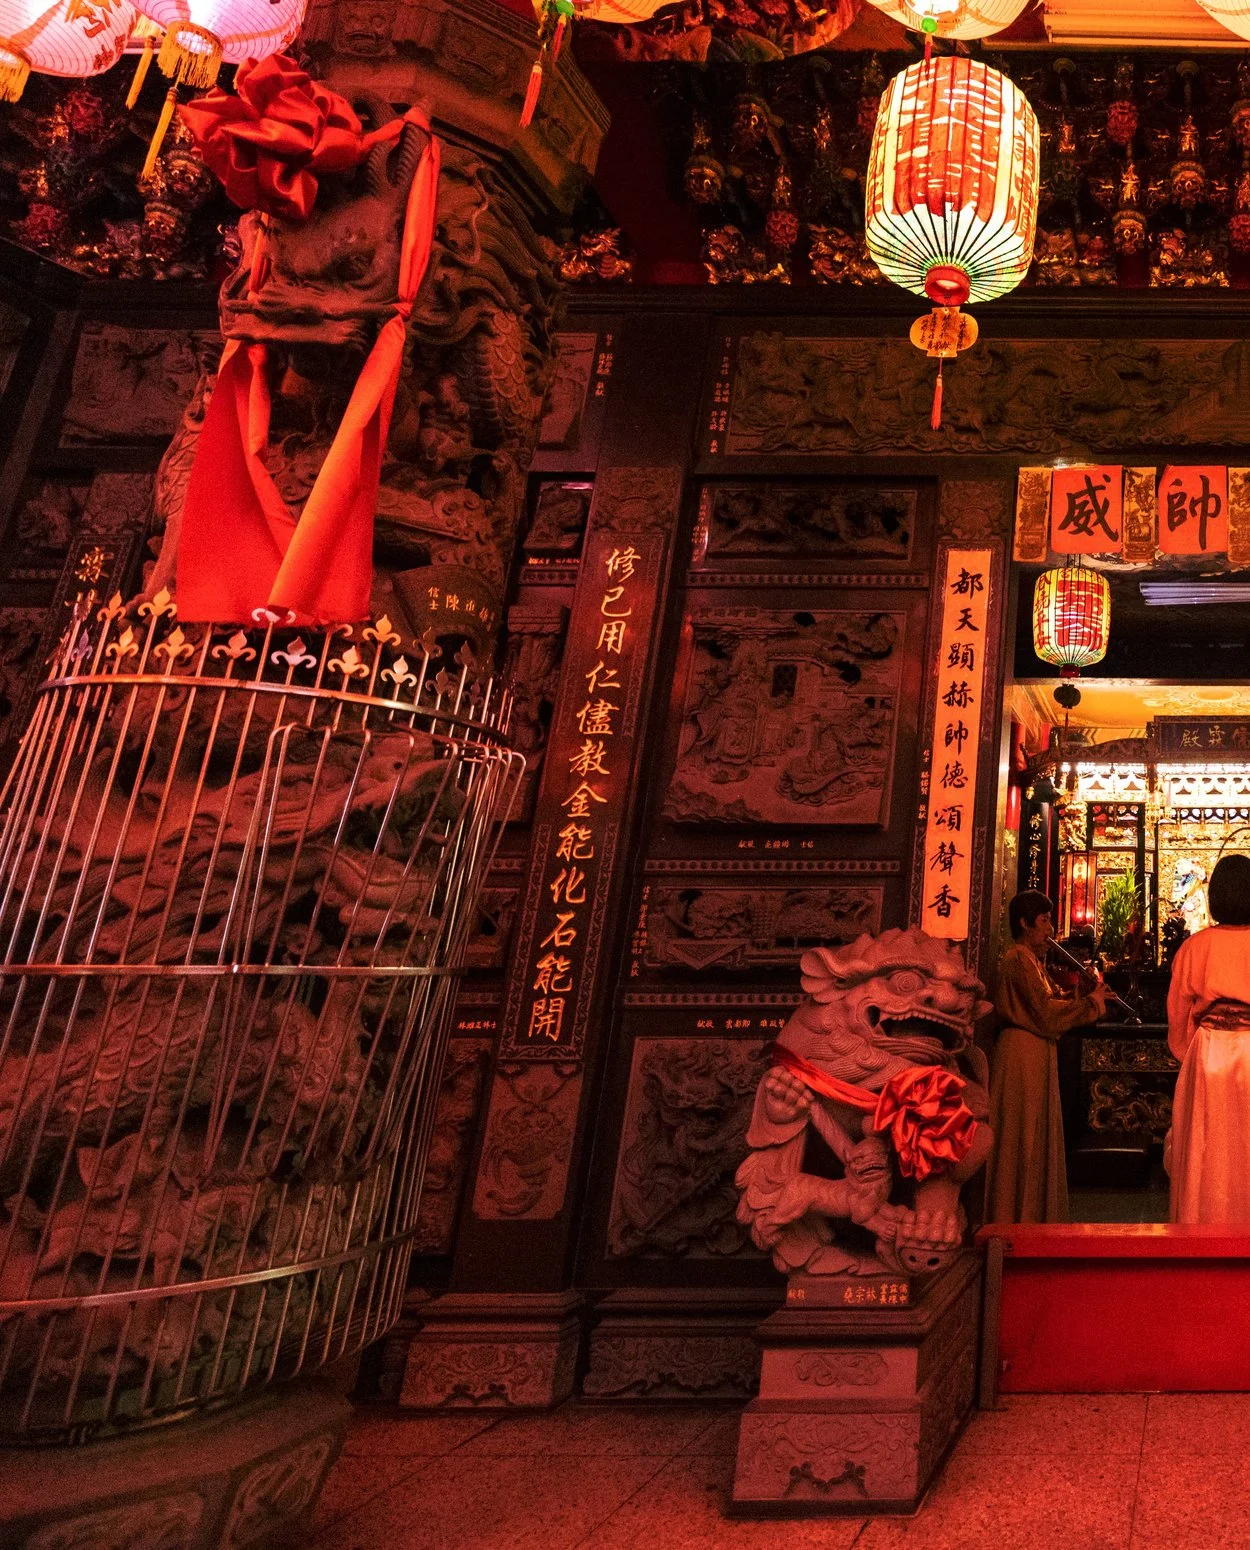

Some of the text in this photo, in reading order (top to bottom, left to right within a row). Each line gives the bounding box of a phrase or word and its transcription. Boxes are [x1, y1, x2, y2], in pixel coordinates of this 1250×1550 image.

[928, 567, 985, 919] 都天顯赫帥德頌聲香
